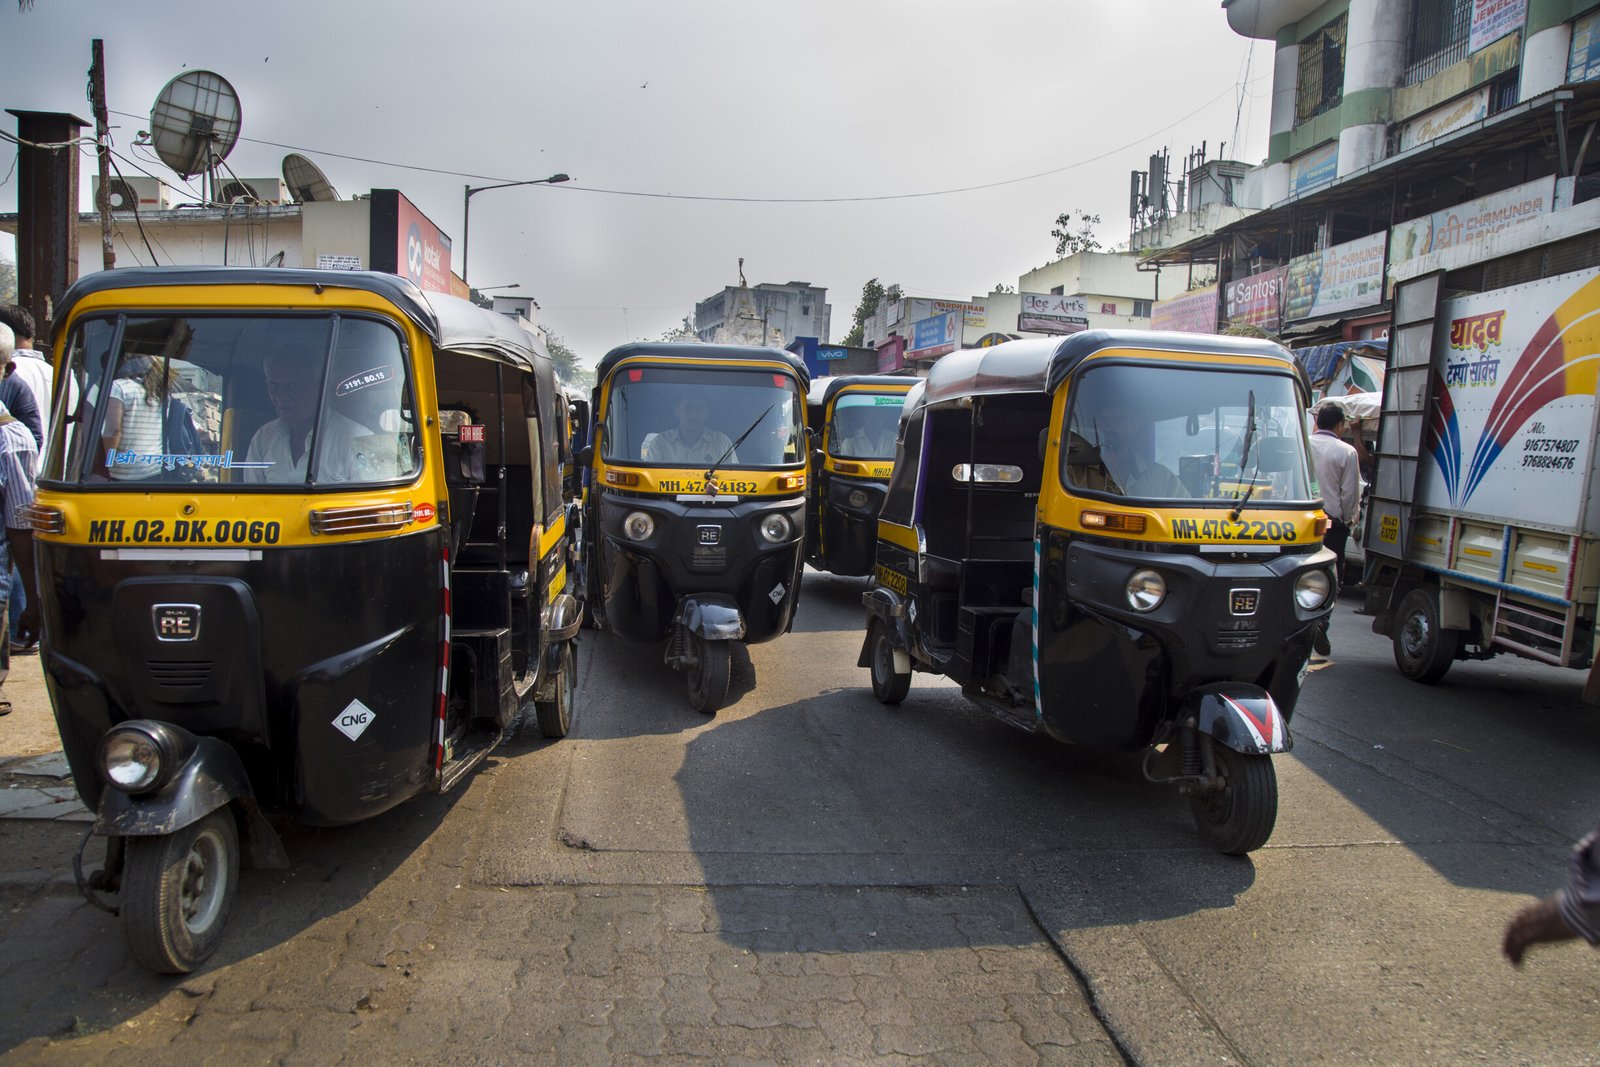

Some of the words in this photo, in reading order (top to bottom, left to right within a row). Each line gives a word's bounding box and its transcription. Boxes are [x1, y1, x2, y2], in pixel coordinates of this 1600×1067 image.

[1474, 0, 1517, 24] JEWEL
[1466, 197, 1545, 231] CHAMUNDA
[937, 301, 985, 312] VARDHAMAN
[1052, 299, 1084, 314] Art's
[1450, 310, 1506, 352] यादव
[1523, 439, 1580, 453] 9167574807
[1522, 455, 1576, 470] 9768824676
[88, 519, 281, 545] MH.02.DK.0060
[701, 531, 718, 541] RE
[1234, 597, 1255, 610] RE
[160, 616, 192, 634] RE
[341, 712, 367, 727] CNG
